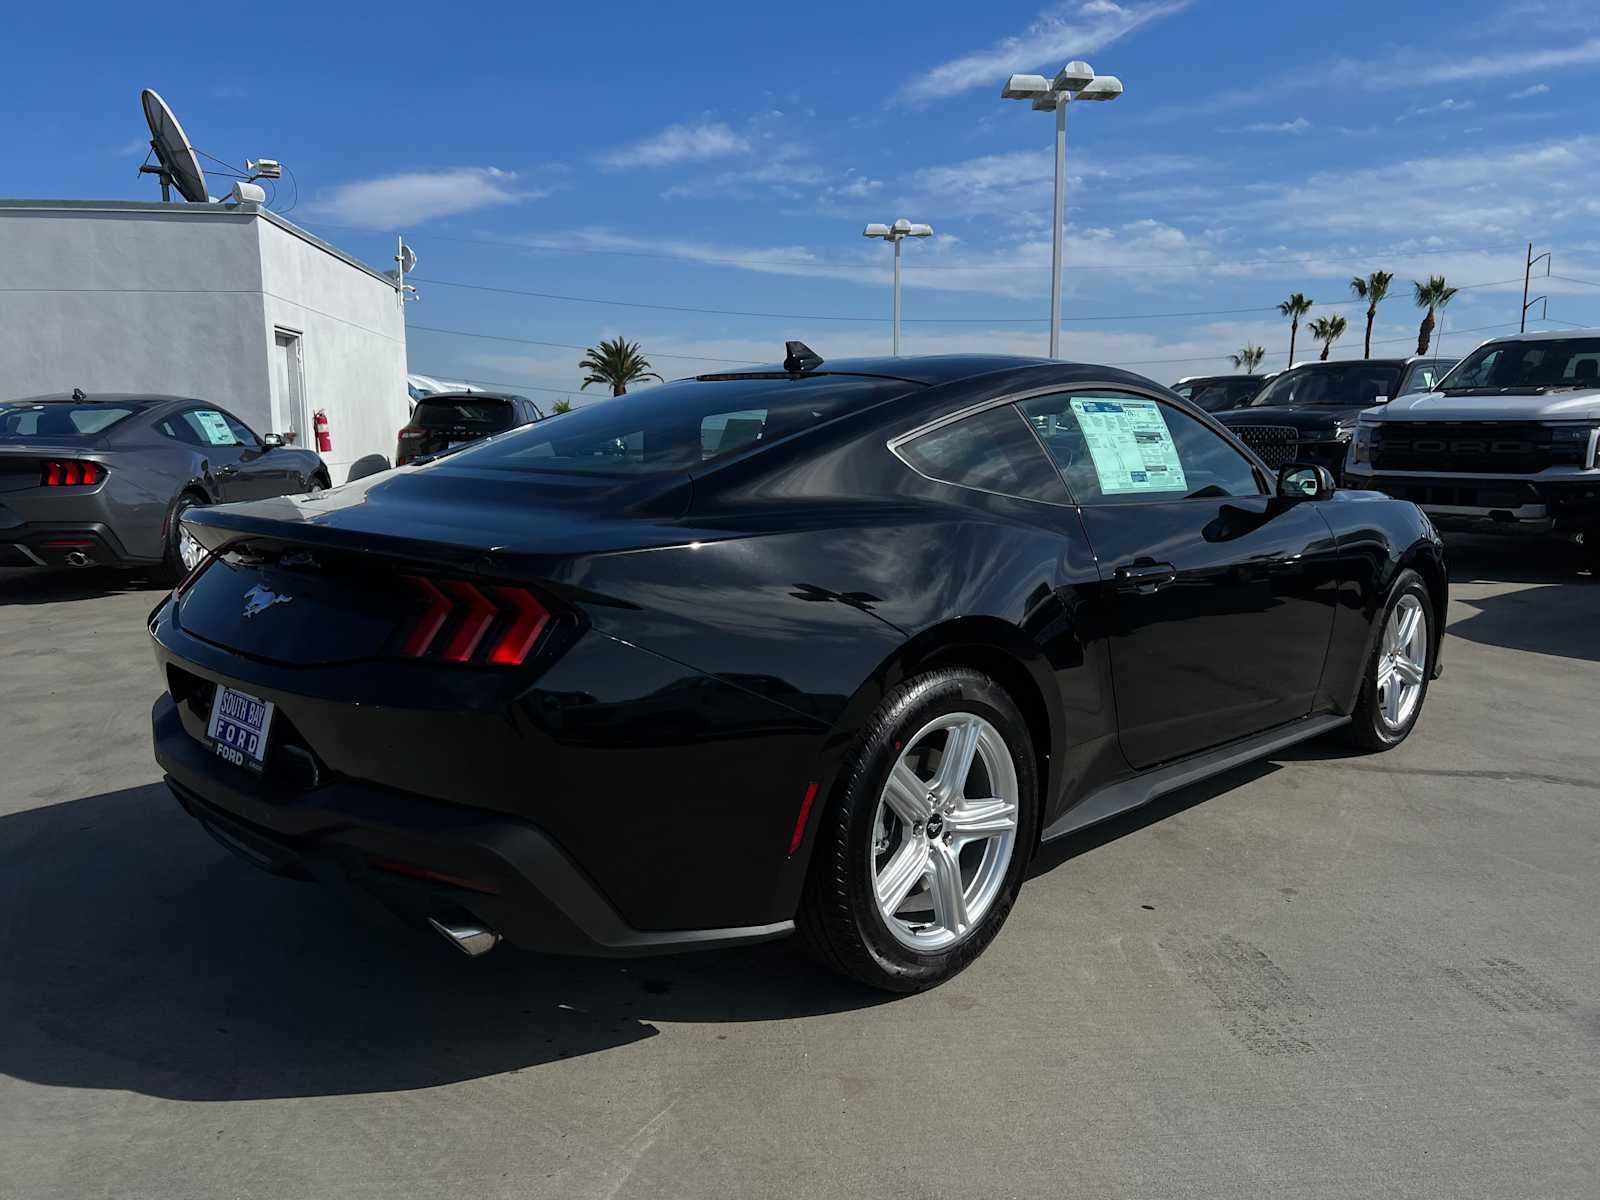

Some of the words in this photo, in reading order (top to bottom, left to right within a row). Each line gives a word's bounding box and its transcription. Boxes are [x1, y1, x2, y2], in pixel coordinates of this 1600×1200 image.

[1380, 439, 1534, 455] FORD
[221, 692, 248, 720] SOUTH
[248, 702, 265, 727] BAY
[216, 720, 258, 753] FORD
[217, 743, 244, 765] FORD
